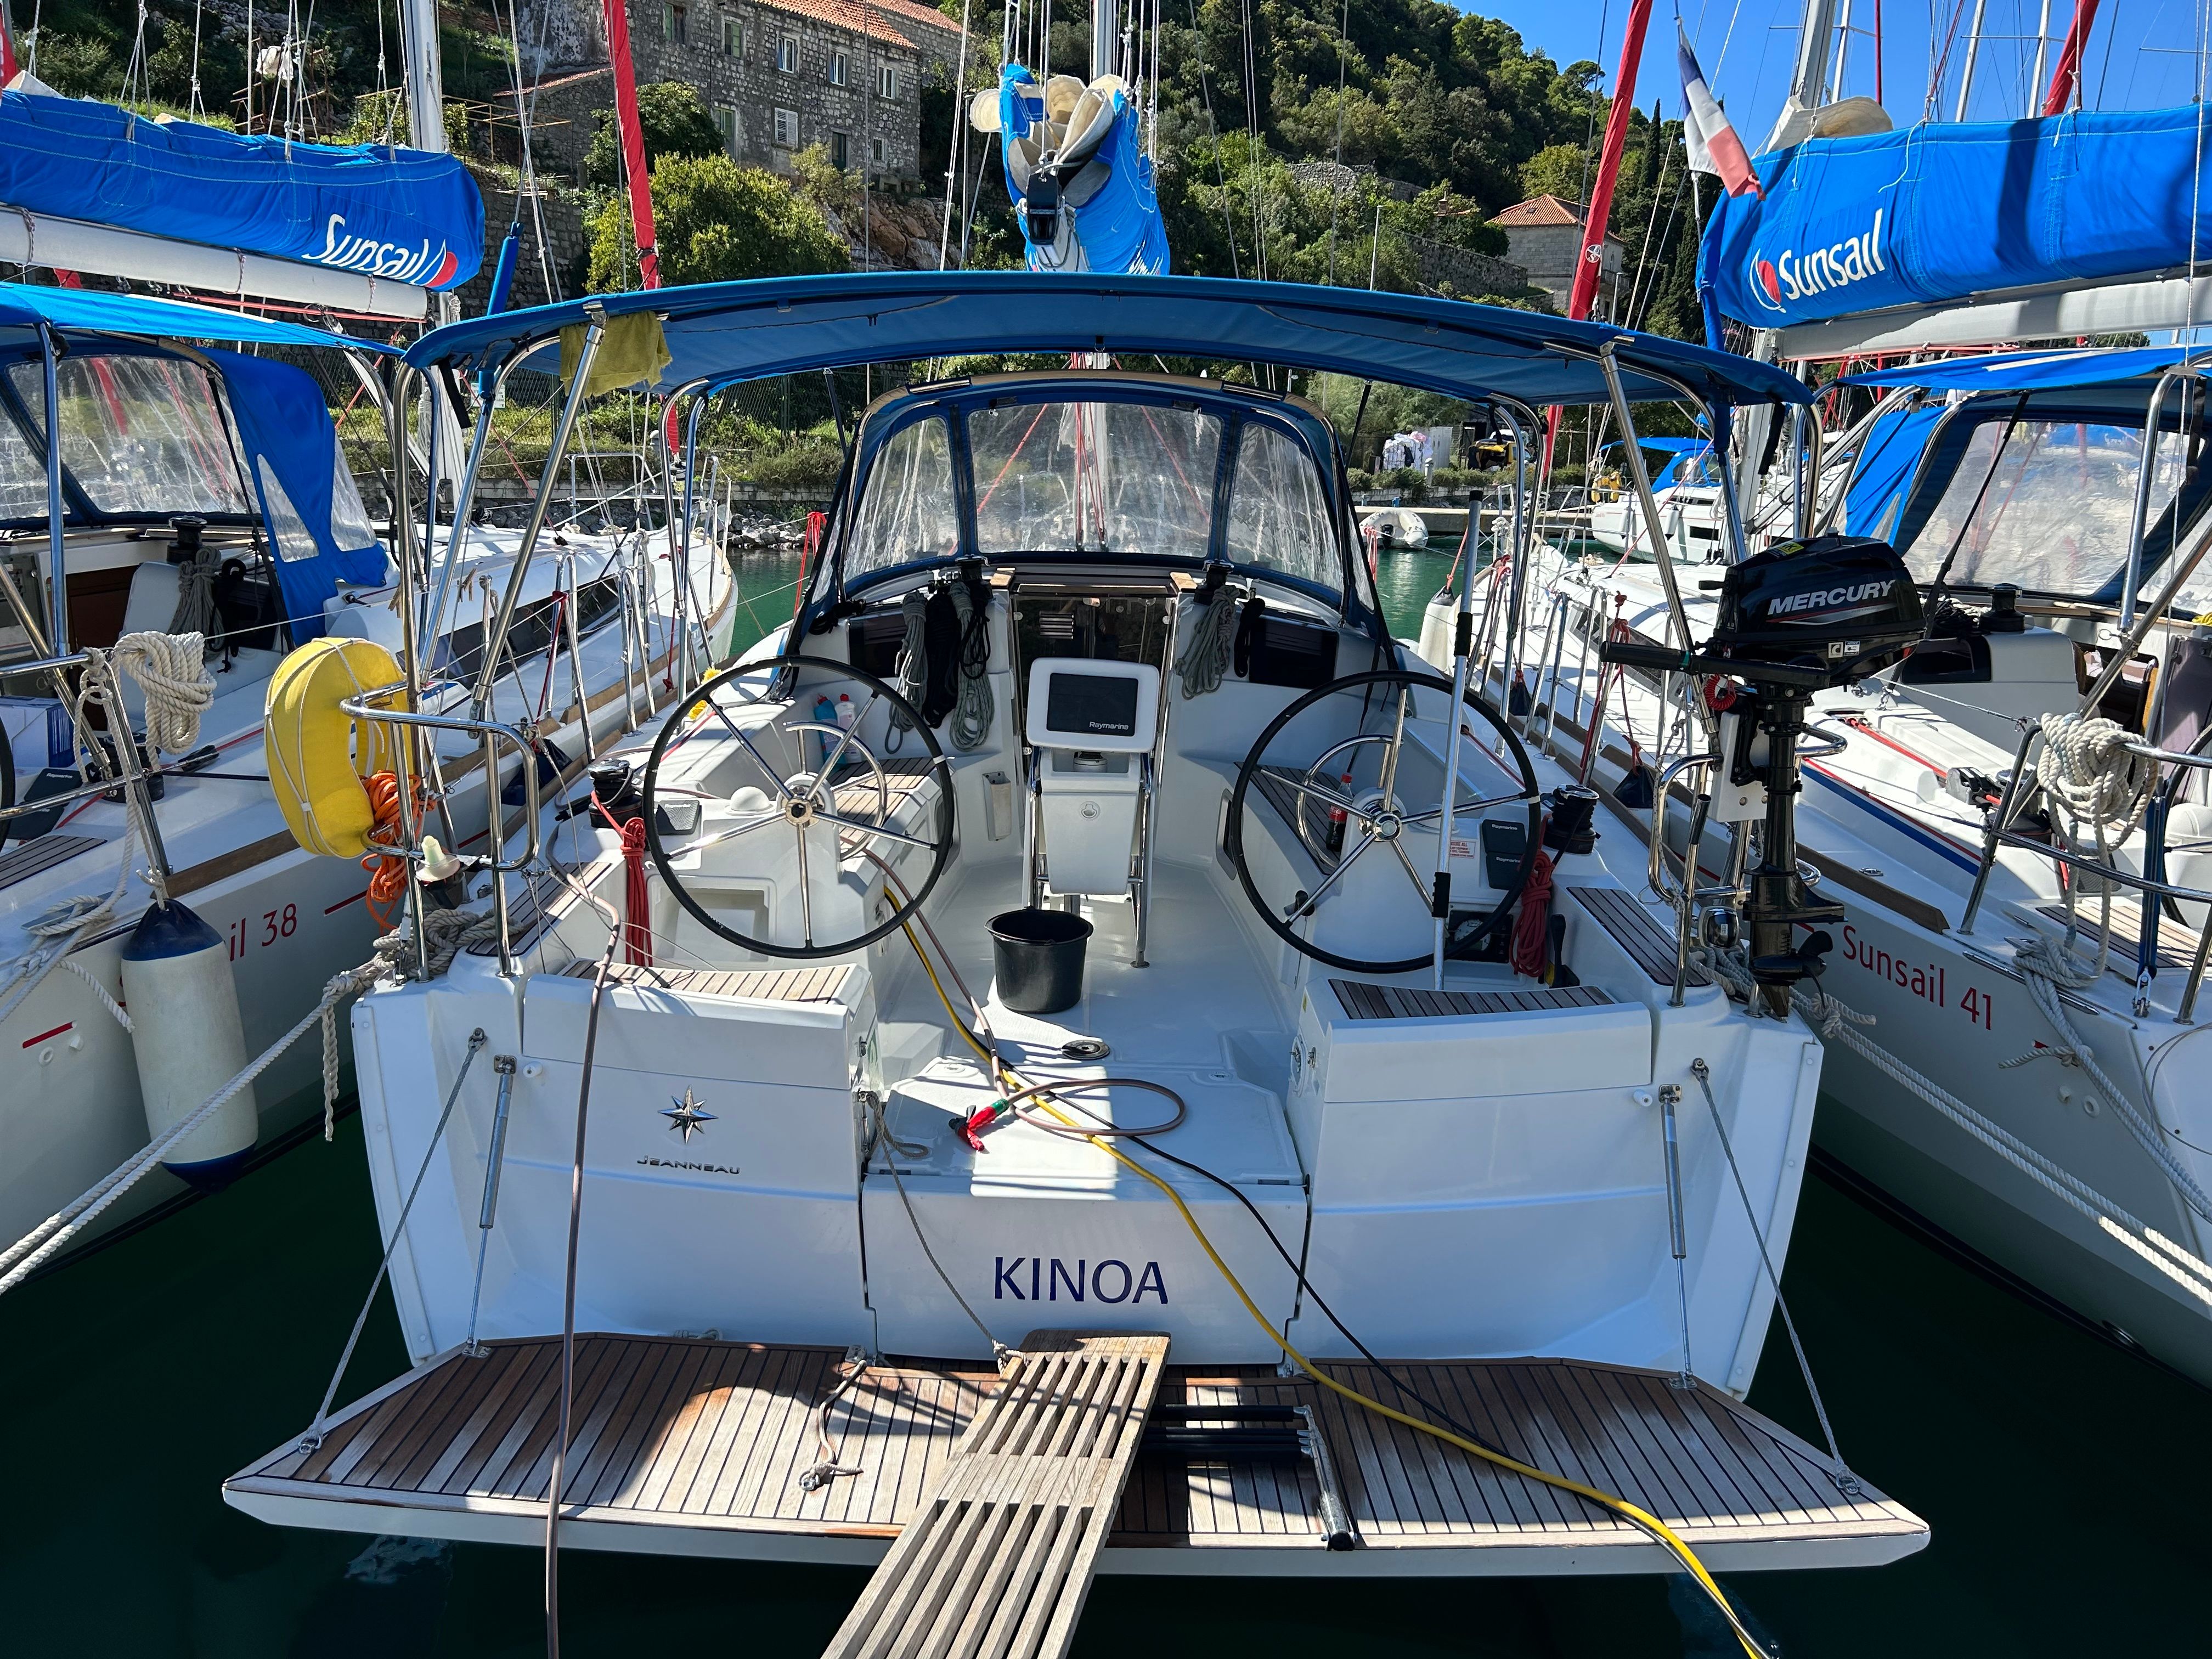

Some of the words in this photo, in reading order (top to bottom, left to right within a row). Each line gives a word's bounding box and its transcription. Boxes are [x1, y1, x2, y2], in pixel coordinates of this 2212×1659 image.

[301, 213, 429, 280] Sunsail
[1779, 207, 1886, 300] Sunsail
[1767, 579, 1896, 615] MERCURY
[1089, 721, 1129, 730] Raymarine
[262, 903, 297, 947] 38
[1843, 925, 1944, 1008] Sunsail
[1960, 987, 1991, 1030] 41
[637, 1154, 741, 1175] JEANNEAU
[994, 1256, 1169, 1305] KINOA
